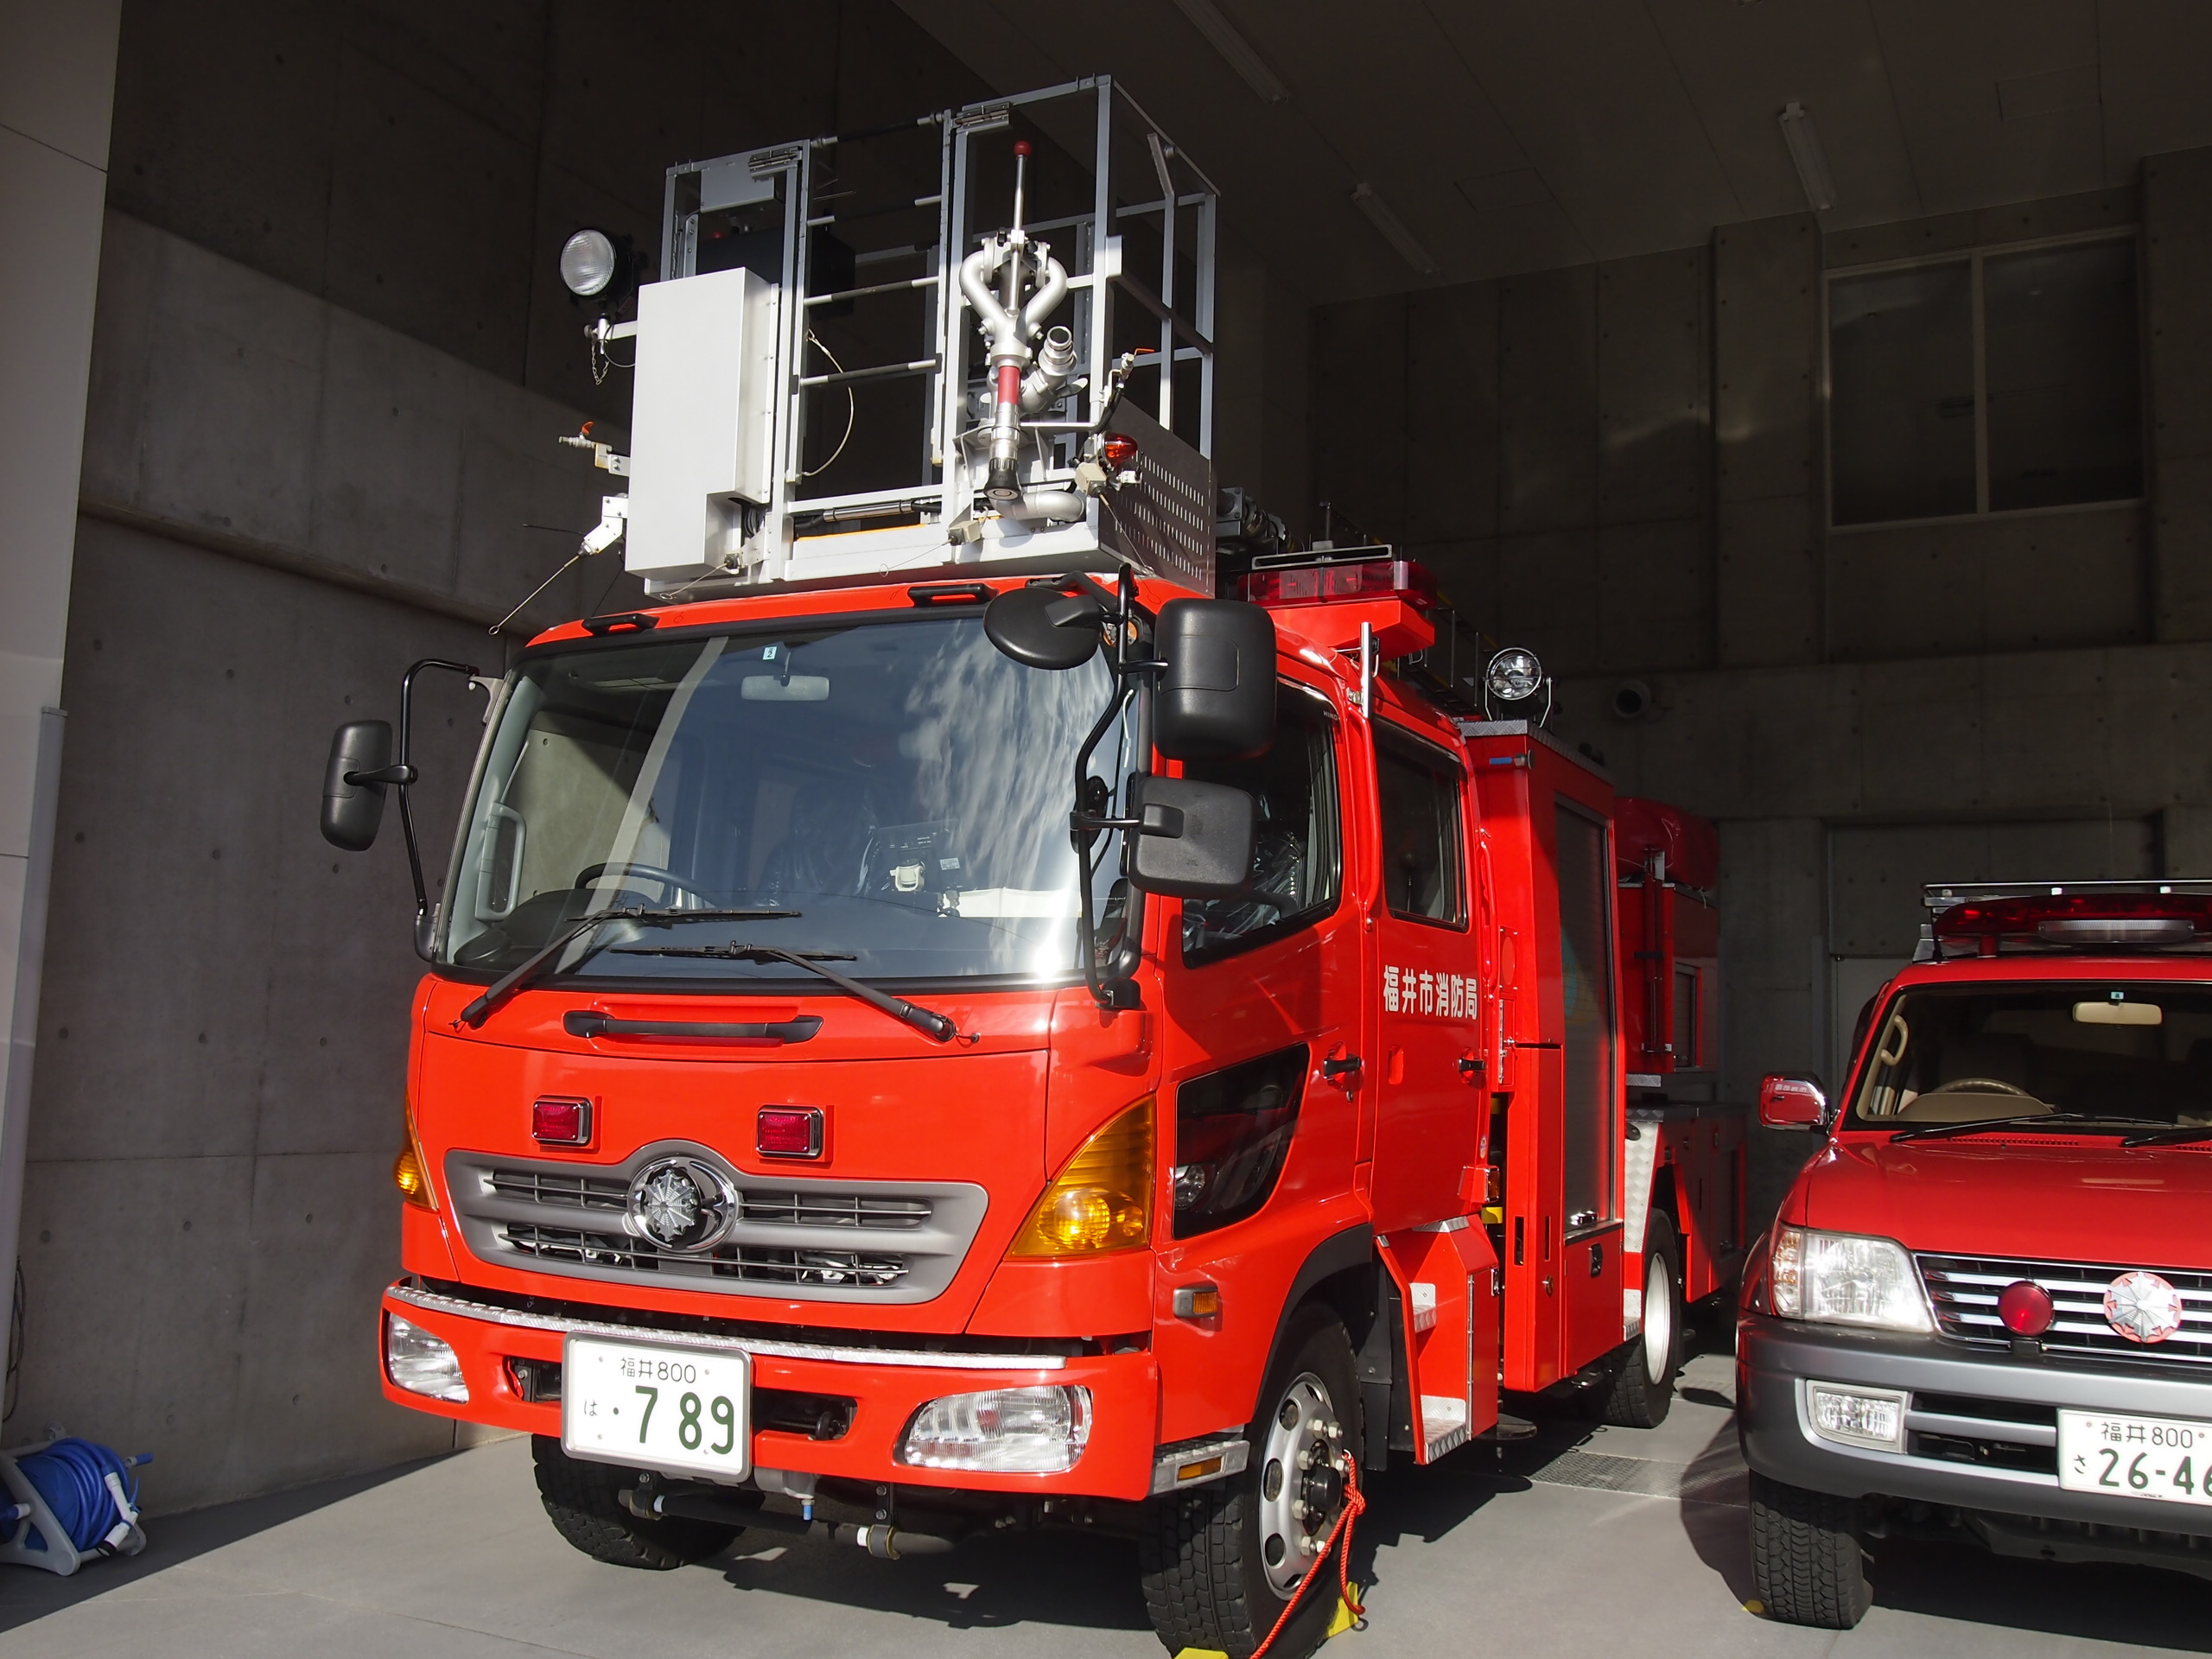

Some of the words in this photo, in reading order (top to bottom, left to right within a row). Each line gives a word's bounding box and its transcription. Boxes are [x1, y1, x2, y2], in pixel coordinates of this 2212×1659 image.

[1383, 964, 1478, 1020] 福井市消防局
[583, 1399, 598, 1416] は
[2073, 1454, 2087, 1474] さ
